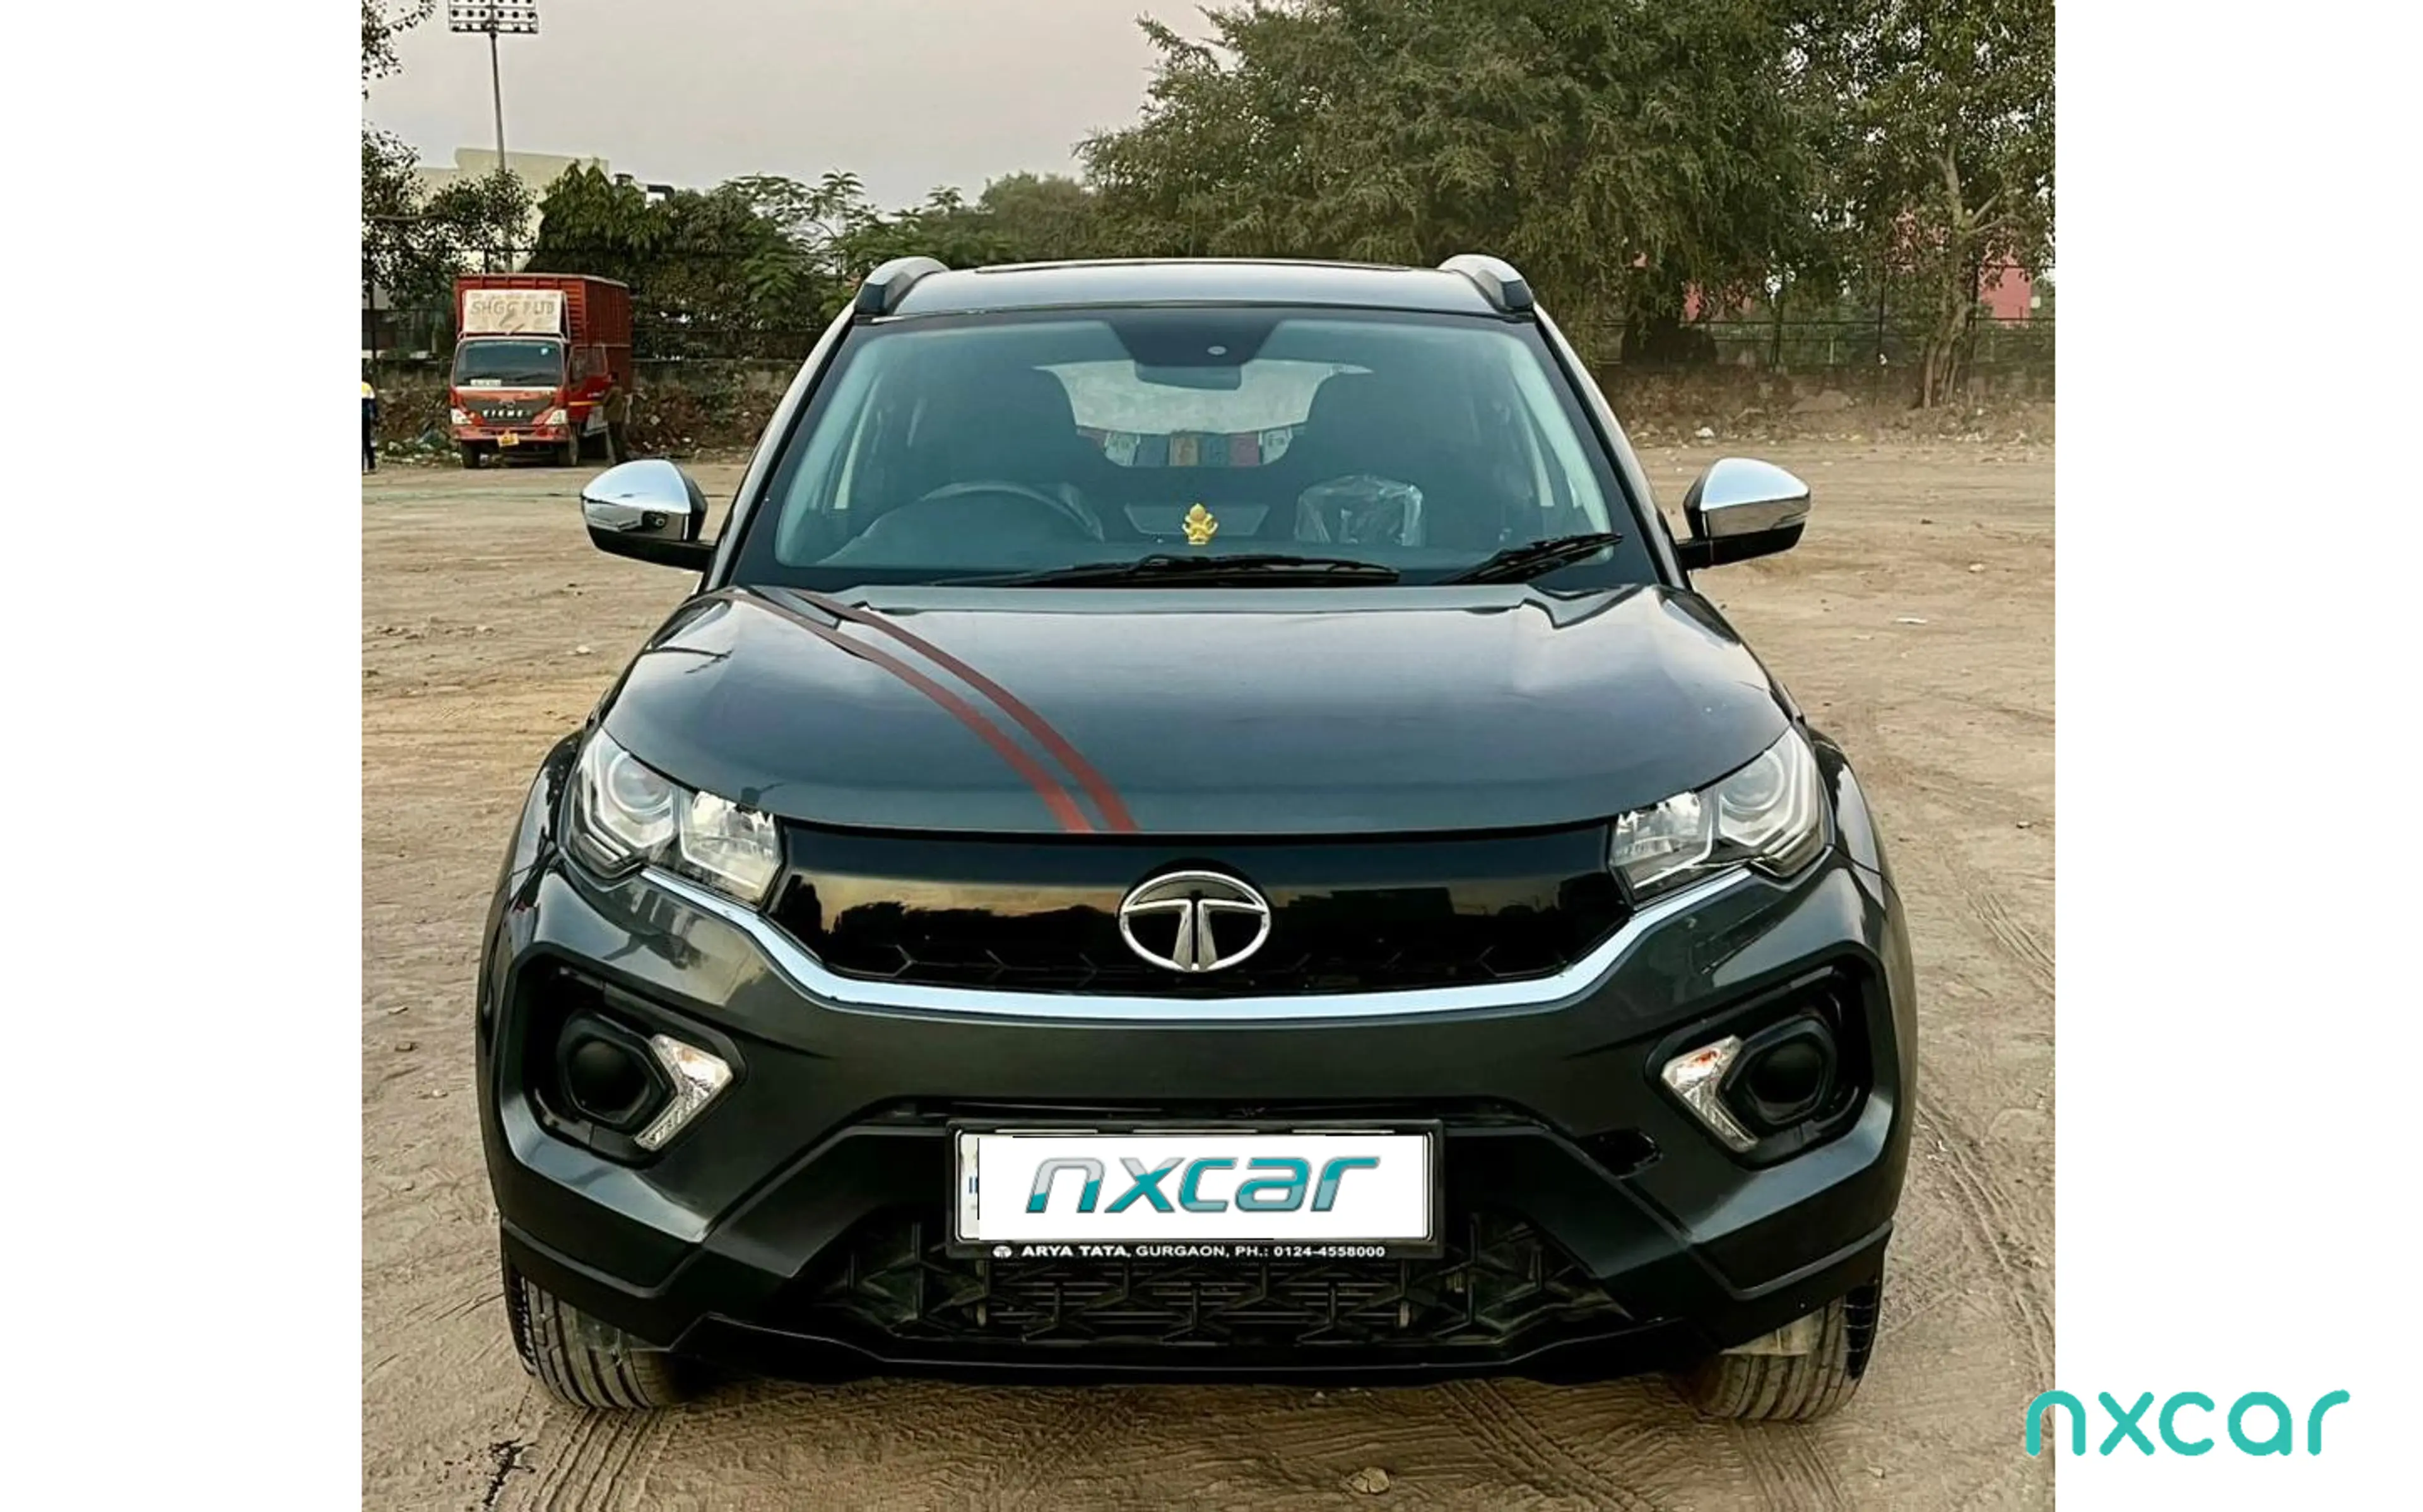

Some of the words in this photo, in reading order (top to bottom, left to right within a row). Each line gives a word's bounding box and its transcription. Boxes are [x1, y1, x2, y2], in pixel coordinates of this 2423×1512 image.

[1020, 1245, 1073, 1257] ARYA
[1078, 1245, 1132, 1258] TATA,
[1135, 1245, 1230, 1258] GURGAON,
[1273, 1245, 1386, 1258] 0124-4558000
